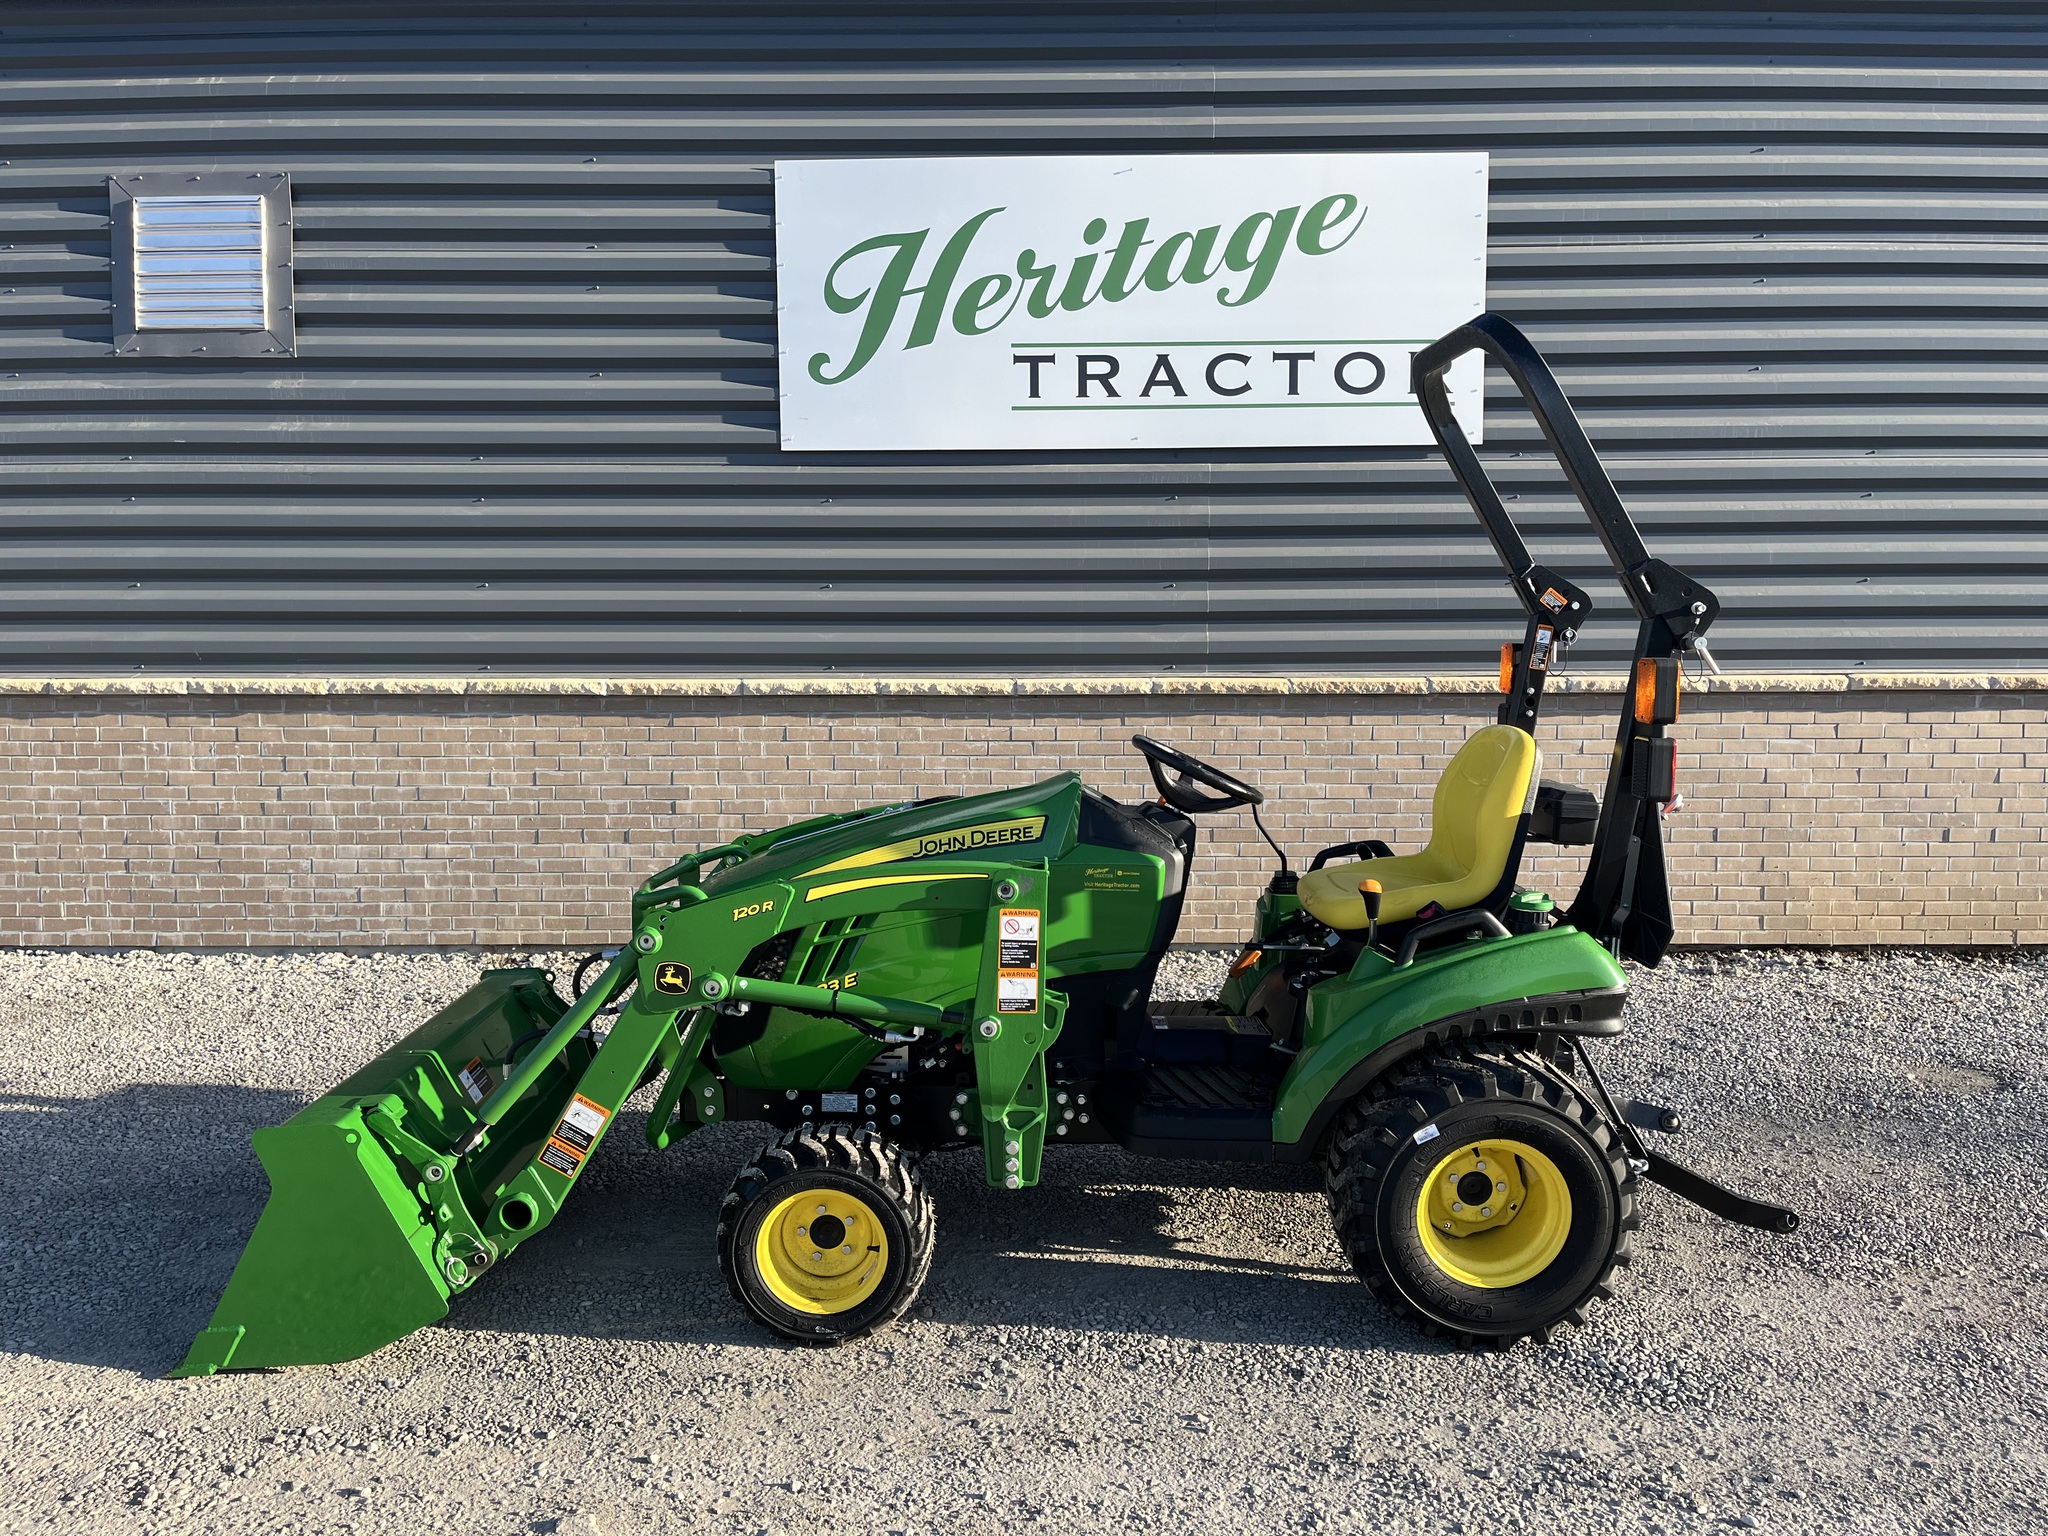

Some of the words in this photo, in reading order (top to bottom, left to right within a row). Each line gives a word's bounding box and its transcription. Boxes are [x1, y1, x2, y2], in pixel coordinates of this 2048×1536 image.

[807, 194, 1368, 386] Heritage
[912, 835, 965, 857] JOHN
[971, 825, 1034, 846] DEERE
[732, 904, 760, 922] 120
[762, 900, 774, 914] R
[844, 972, 859, 989] E
[583, 1098, 606, 1115] WARNING
[557, 1144, 581, 1159] WARNING
[1397, 1242, 1494, 1320] CARLSTAR
